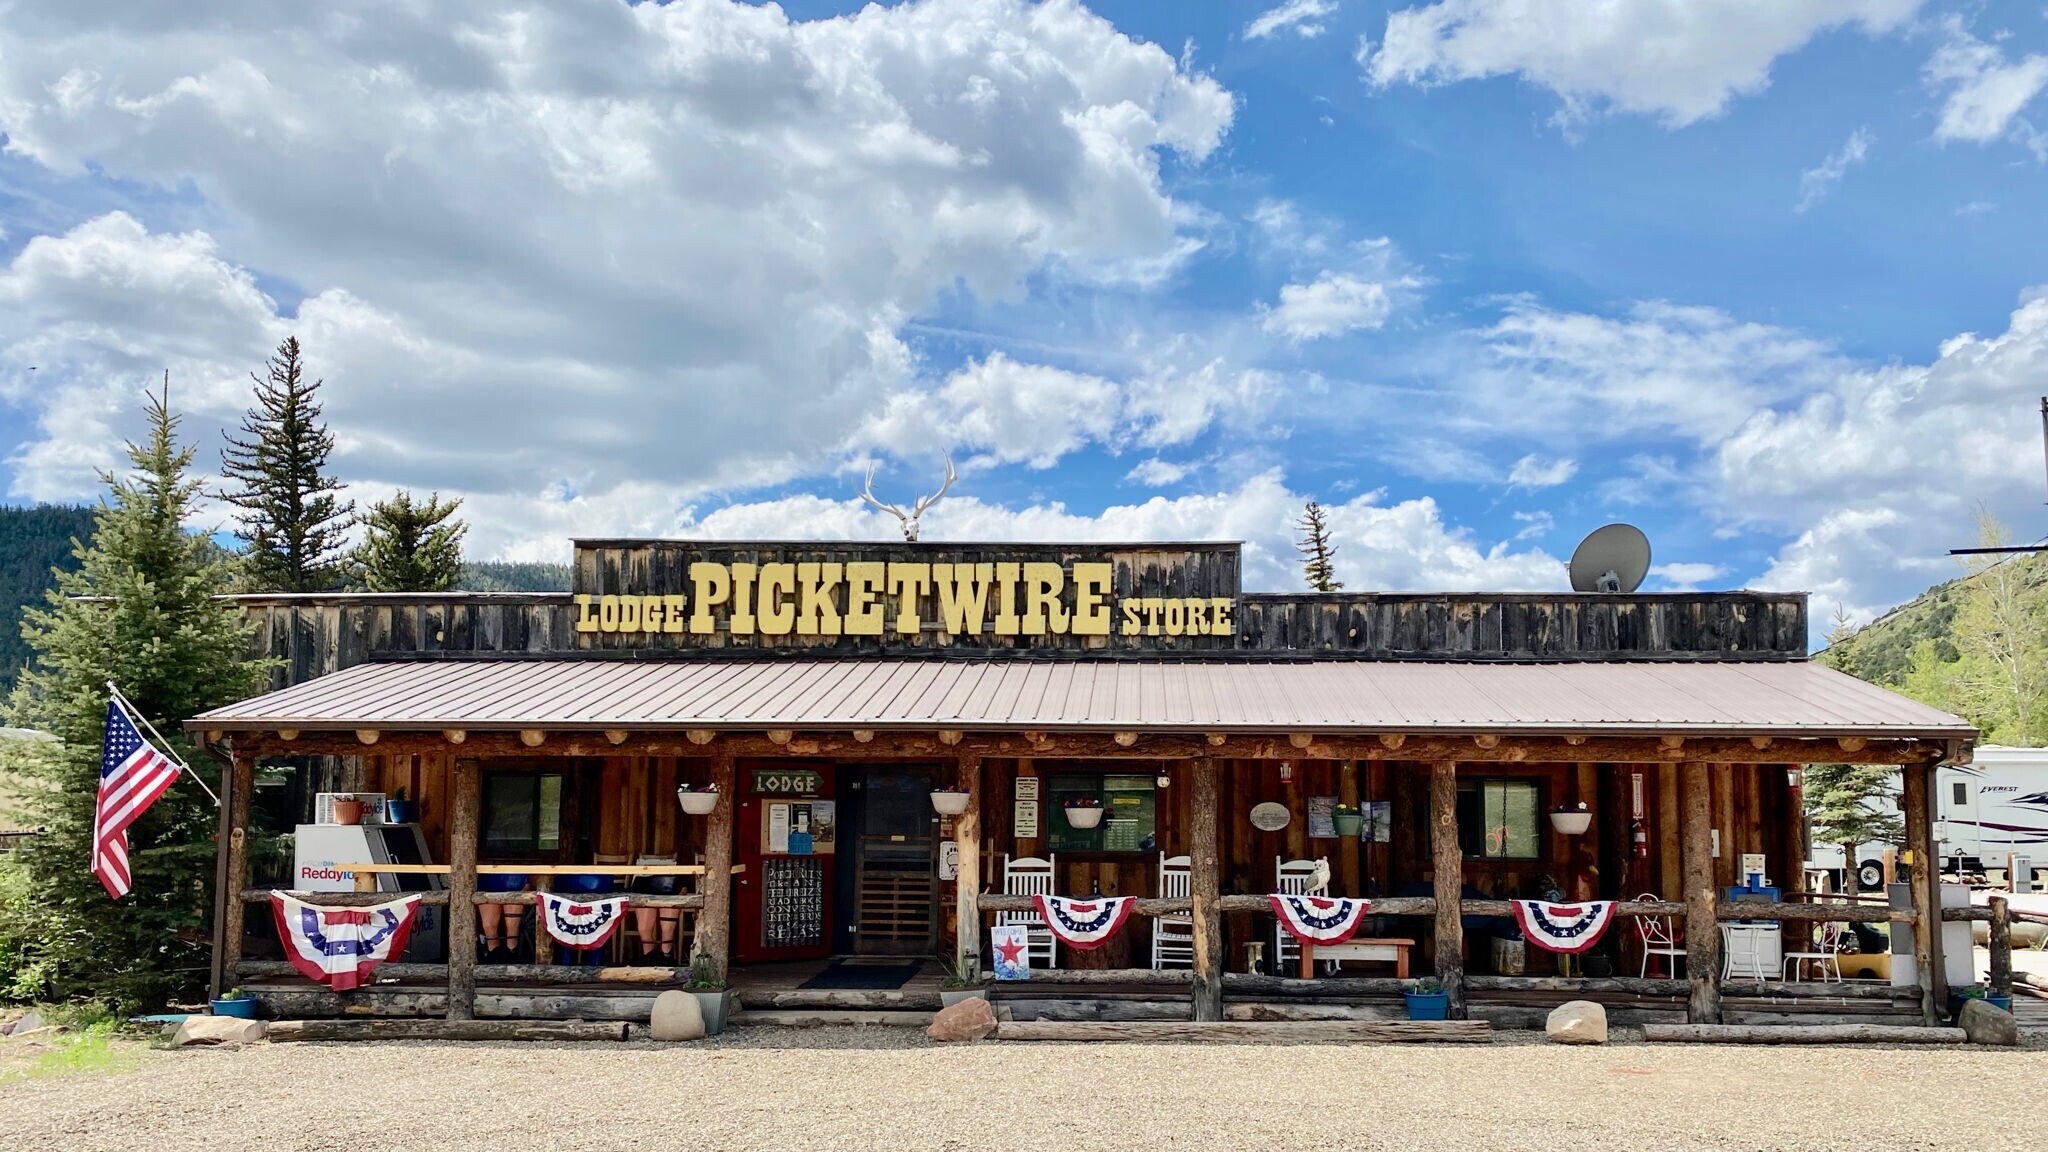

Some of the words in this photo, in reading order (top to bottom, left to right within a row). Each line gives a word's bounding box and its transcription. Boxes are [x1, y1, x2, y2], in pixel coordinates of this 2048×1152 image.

[576, 595, 684, 634] LODGE
[689, 561, 1114, 636] PICKETWIRE
[1121, 597, 1234, 637] STORE
[756, 776, 816, 792] LODGE
[1980, 786, 2019, 794] EVEREST
[767, 904, 822, 914] CONVERSE
